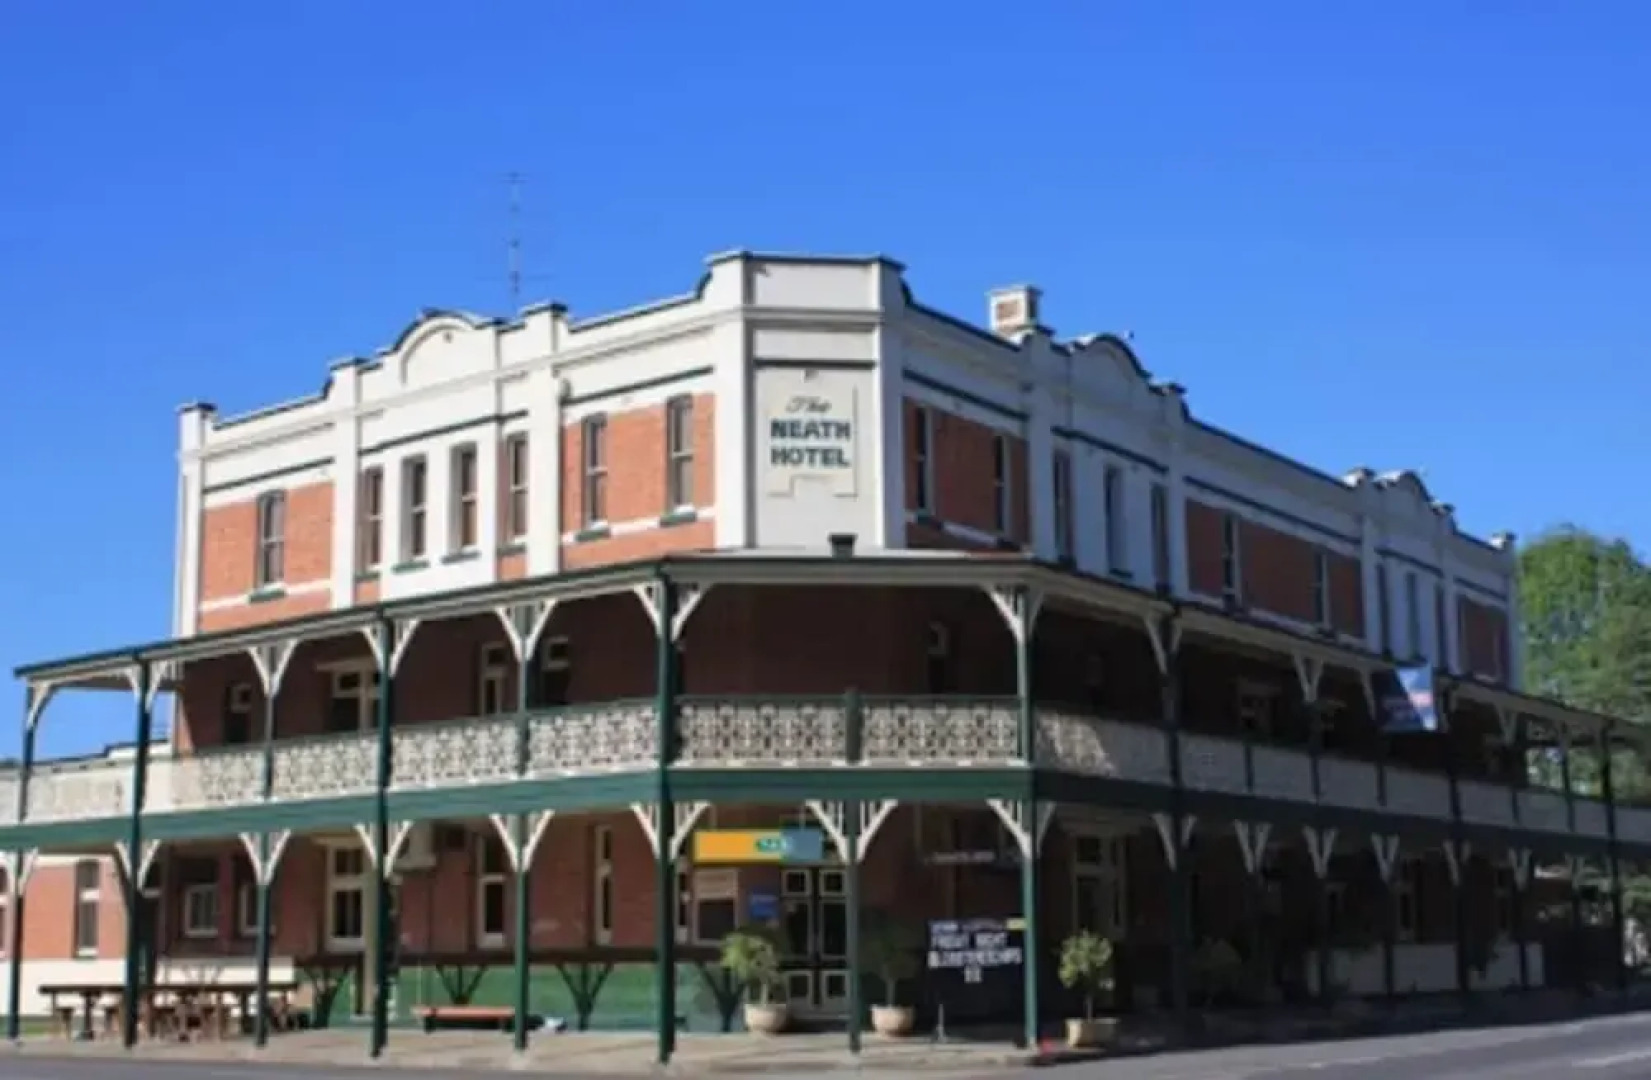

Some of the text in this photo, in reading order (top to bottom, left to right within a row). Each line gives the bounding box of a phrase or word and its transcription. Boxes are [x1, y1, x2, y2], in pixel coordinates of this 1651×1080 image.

[785, 396, 832, 413] The
[771, 419, 850, 439] NEATH
[771, 447, 850, 467] HOTEL
